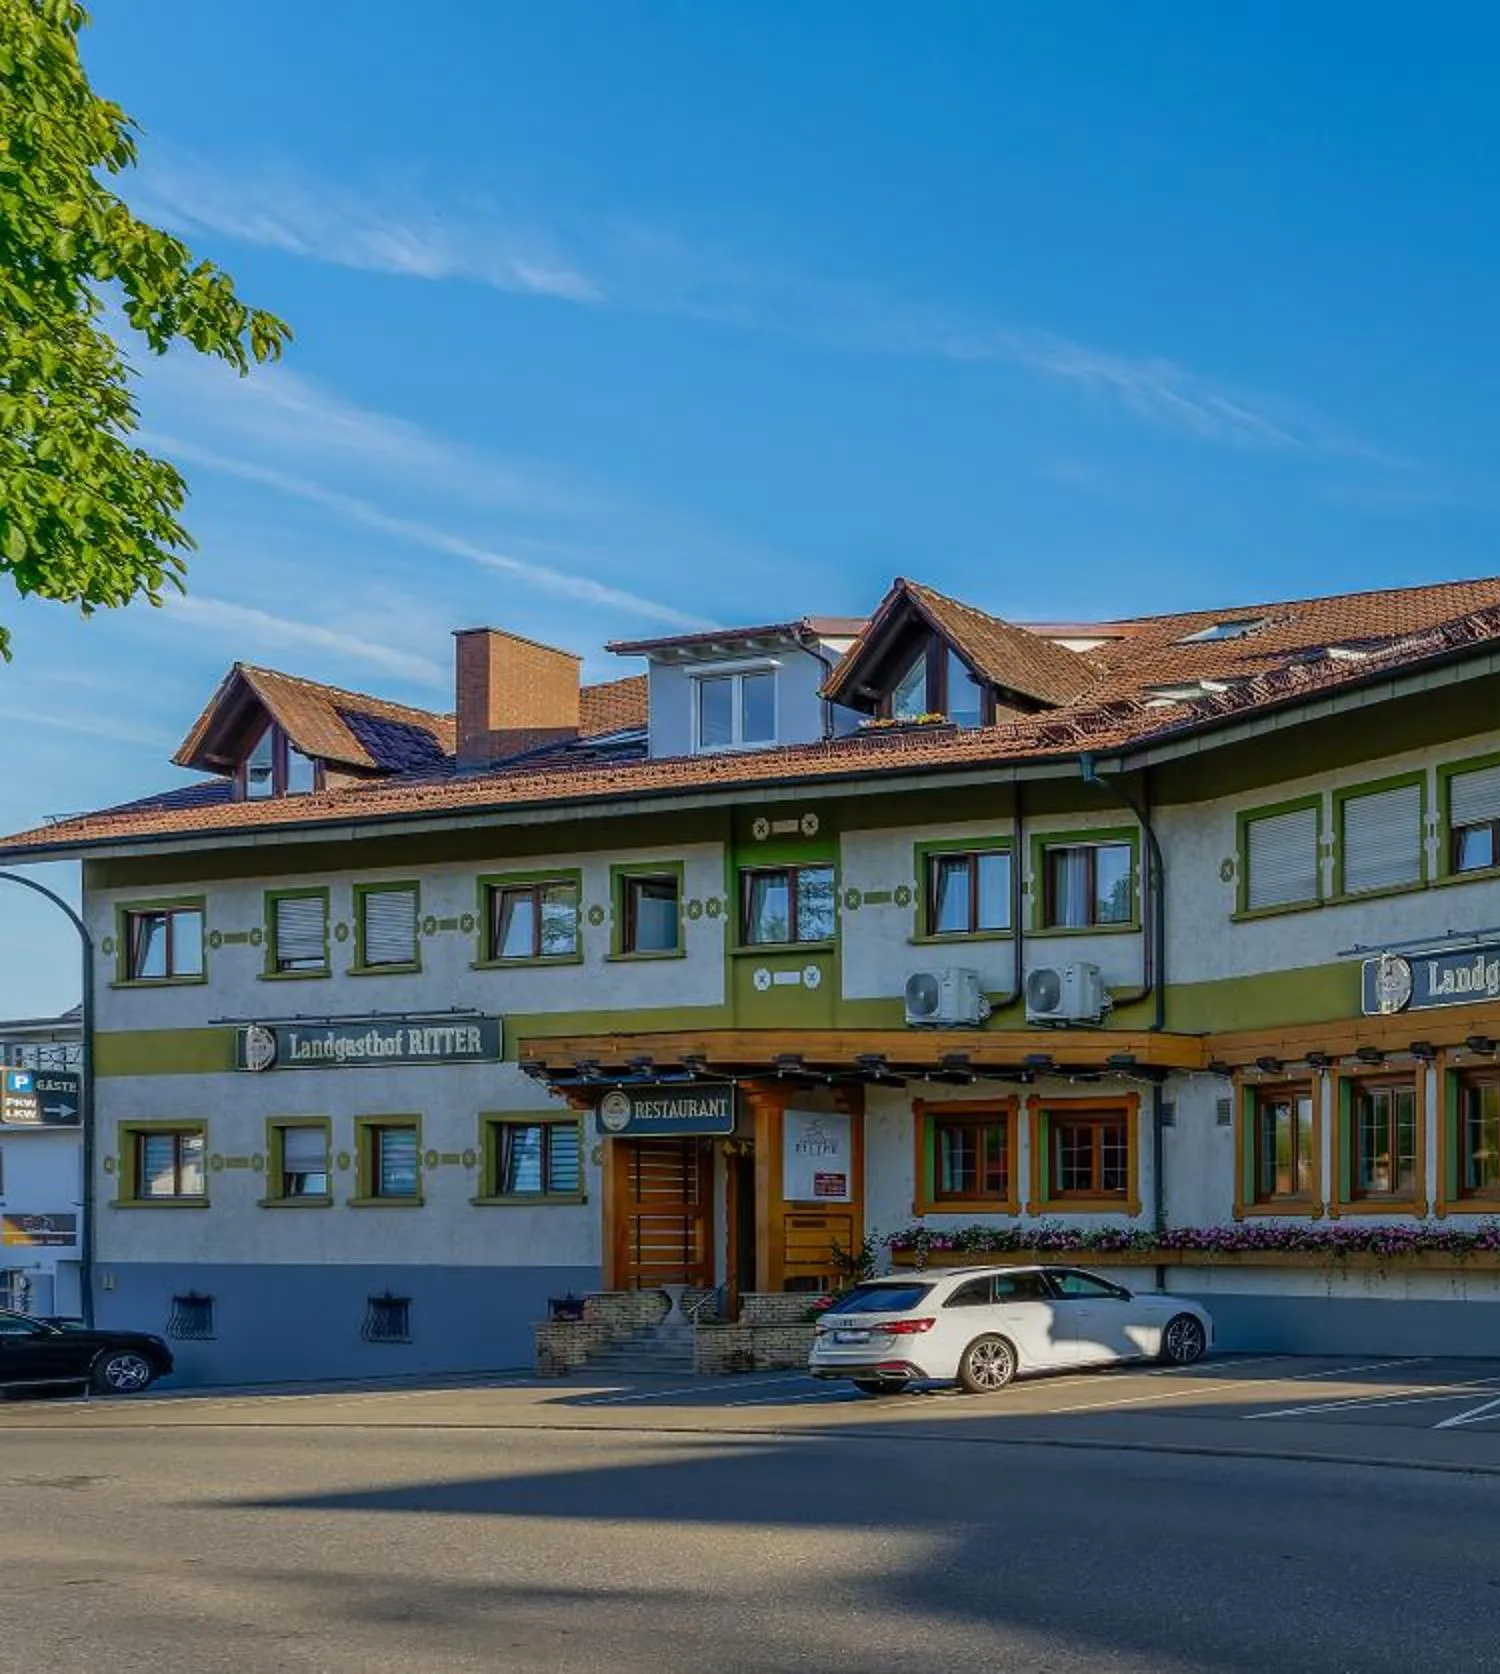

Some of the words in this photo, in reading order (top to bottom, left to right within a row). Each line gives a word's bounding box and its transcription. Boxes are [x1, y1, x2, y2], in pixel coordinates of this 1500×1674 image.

[289, 1030, 403, 1061] Landgasthof
[408, 1026, 483, 1056] RITTER
[634, 1099, 728, 1119] RESTAURANT
